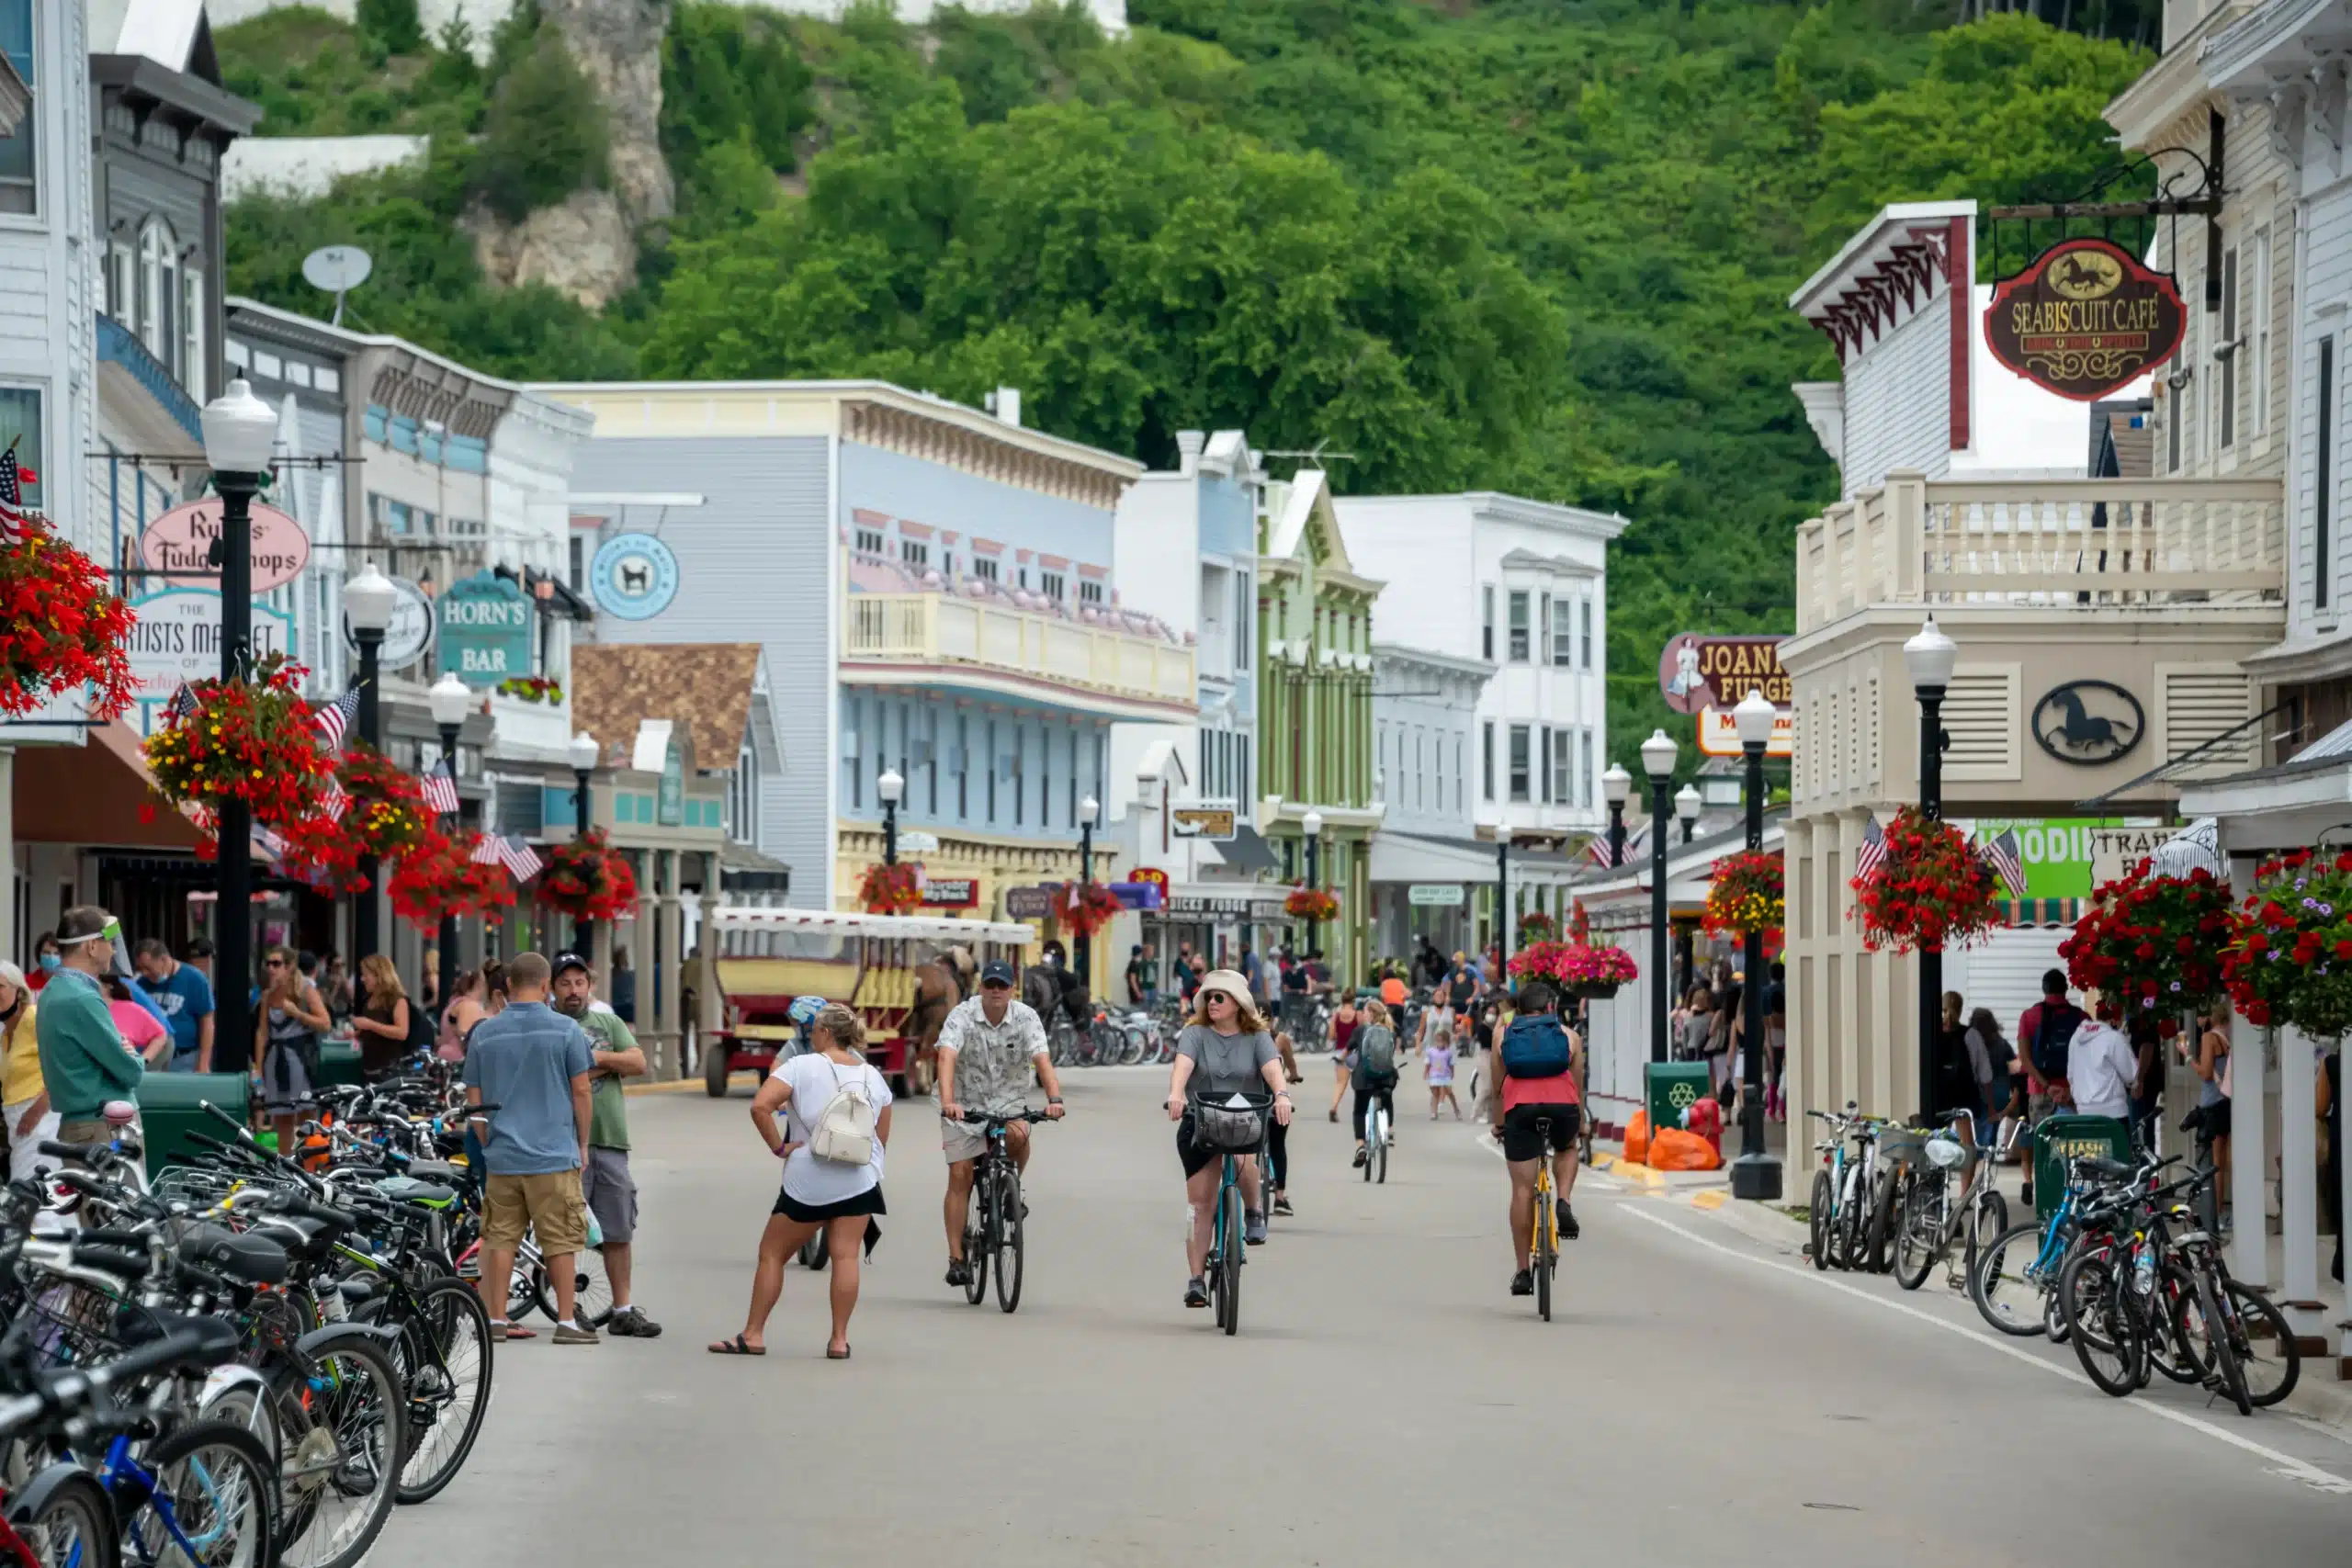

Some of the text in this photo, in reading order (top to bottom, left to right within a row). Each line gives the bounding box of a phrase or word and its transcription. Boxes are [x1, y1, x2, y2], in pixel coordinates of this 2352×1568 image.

[2012, 299, 2110, 333] SEABISCUIT
[177, 603, 205, 615] THE
[444, 601, 526, 626] HORN'S
[116, 622, 274, 658] RTISTS MAET
[182, 658, 199, 669] OF
[462, 648, 507, 672] BAR
[1135, 870, 1164, 884] 3-D
[1210, 898, 1247, 911] FUDGE
